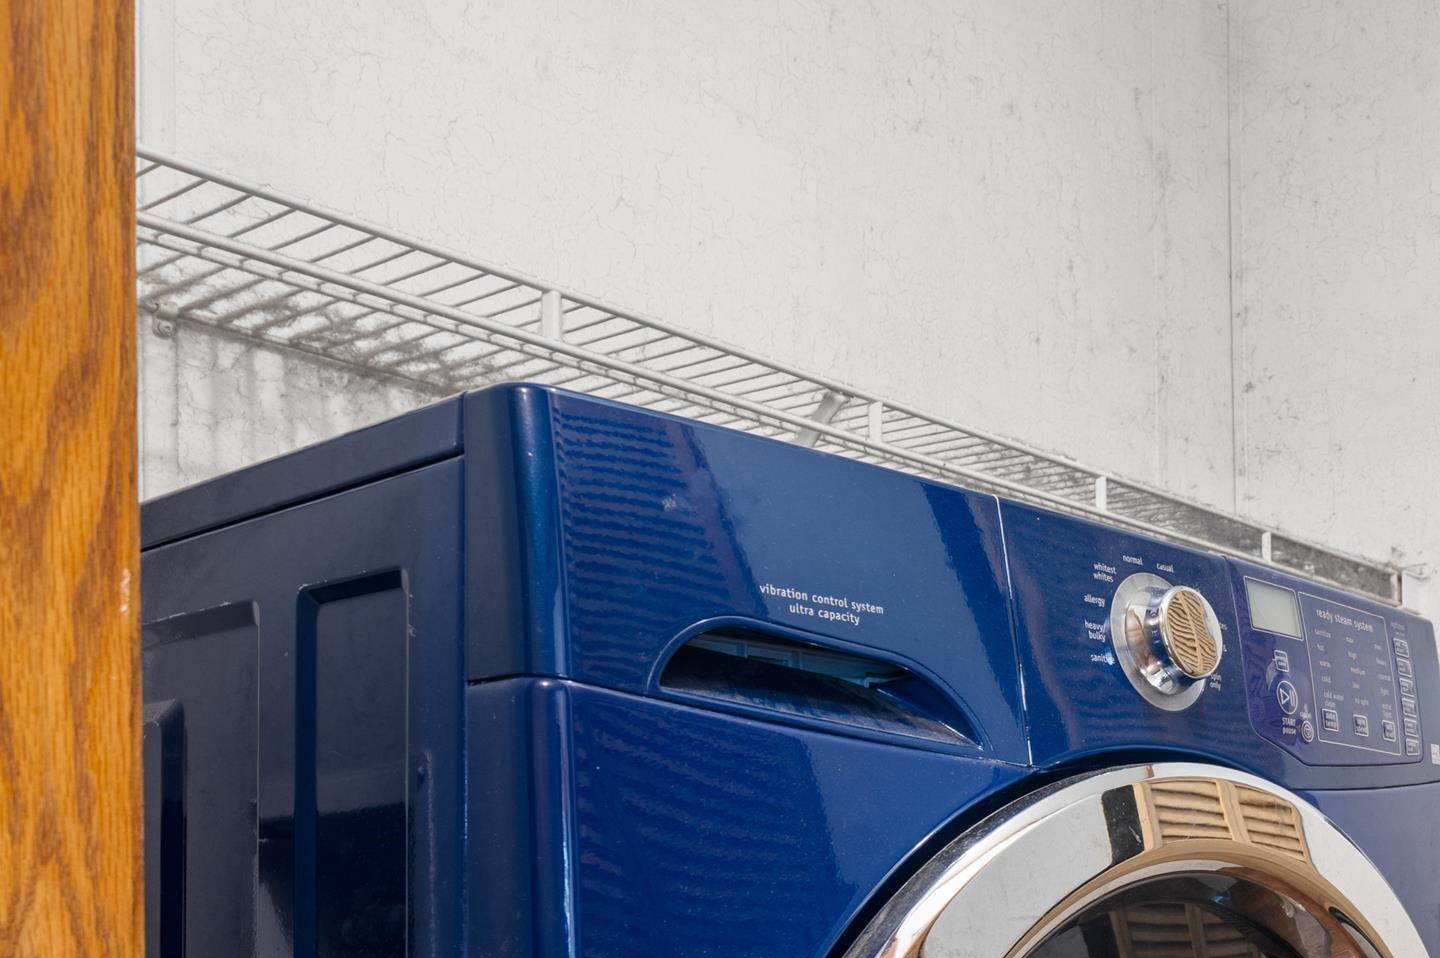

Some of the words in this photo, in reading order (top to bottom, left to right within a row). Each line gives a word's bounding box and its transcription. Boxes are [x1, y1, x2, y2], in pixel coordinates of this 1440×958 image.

[1123, 555, 1143, 566] normal
[1093, 562, 1117, 574] whitest
[1156, 563, 1174, 573] casual
[1093, 572, 1114, 583] whites
[759, 583, 808, 601] vibration
[811, 593, 849, 609] control
[851, 600, 884, 615] system
[1084, 594, 1105, 608] allergy
[789, 602, 815, 617] ultra
[817, 608, 860, 626] capacity
[1315, 609, 1333, 624] ready
[1334, 613, 1353, 626] steam
[1353, 620, 1374, 633] system
[1088, 630, 1106, 643] bulky
[1281, 717, 1296, 727] START
[1282, 726, 1297, 736] pause
